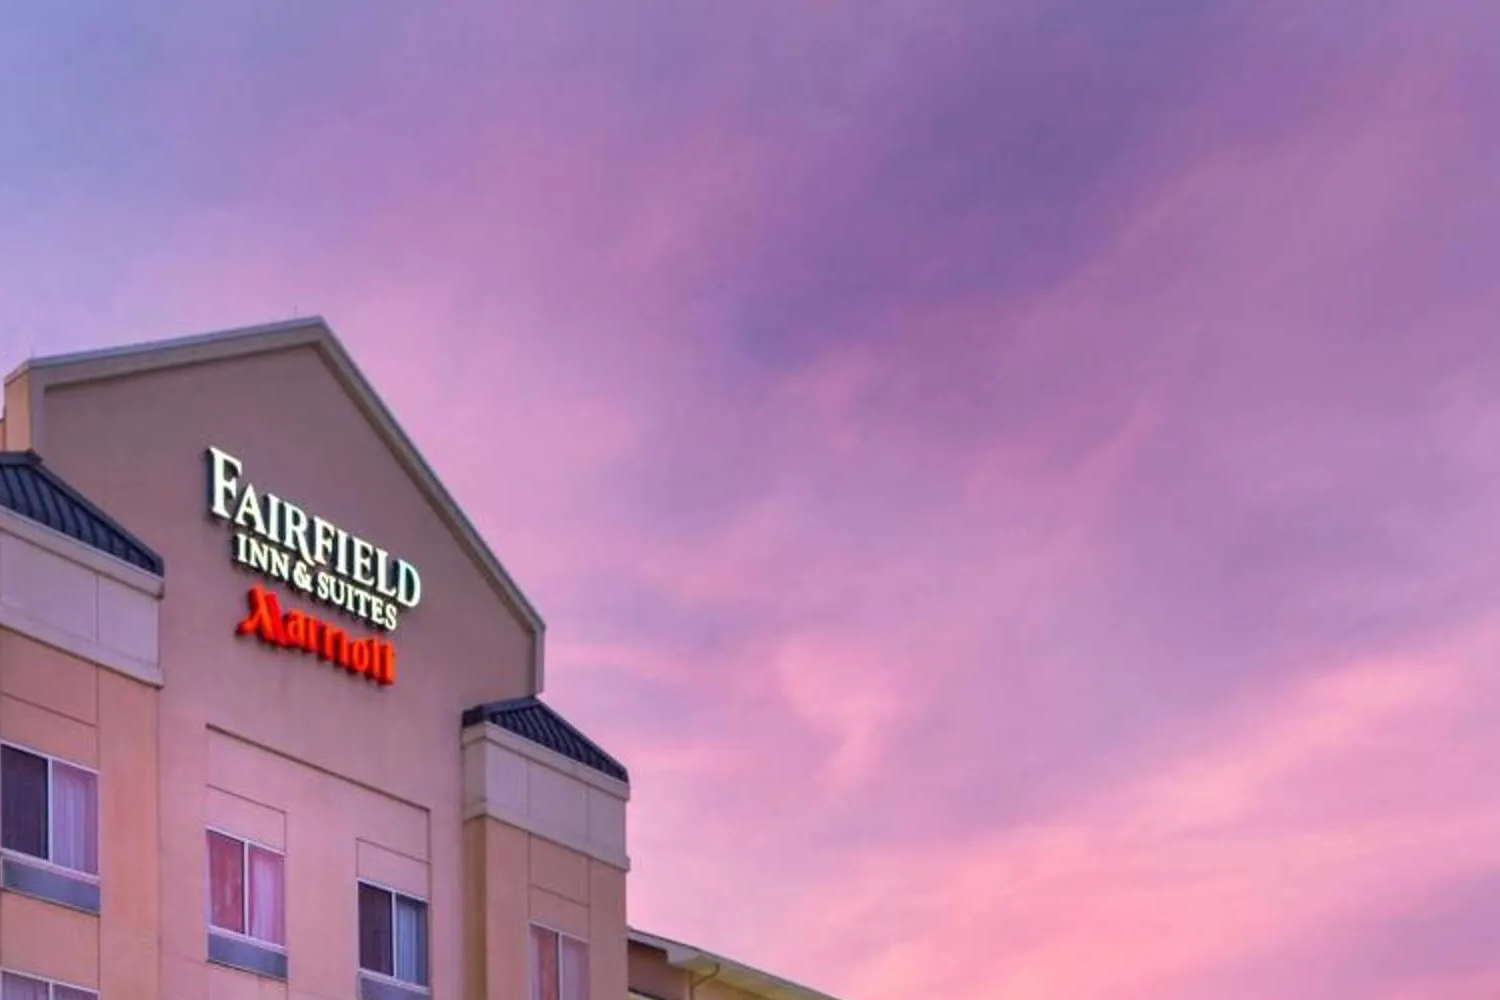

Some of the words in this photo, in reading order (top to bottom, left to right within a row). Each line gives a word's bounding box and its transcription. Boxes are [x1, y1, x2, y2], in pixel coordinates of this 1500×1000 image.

[208, 446, 421, 608] FAIRFIELD
[237, 533, 290, 580] INN
[293, 560, 314, 592] &
[317, 571, 398, 631] SUITES
[236, 583, 396, 685] Marriott
